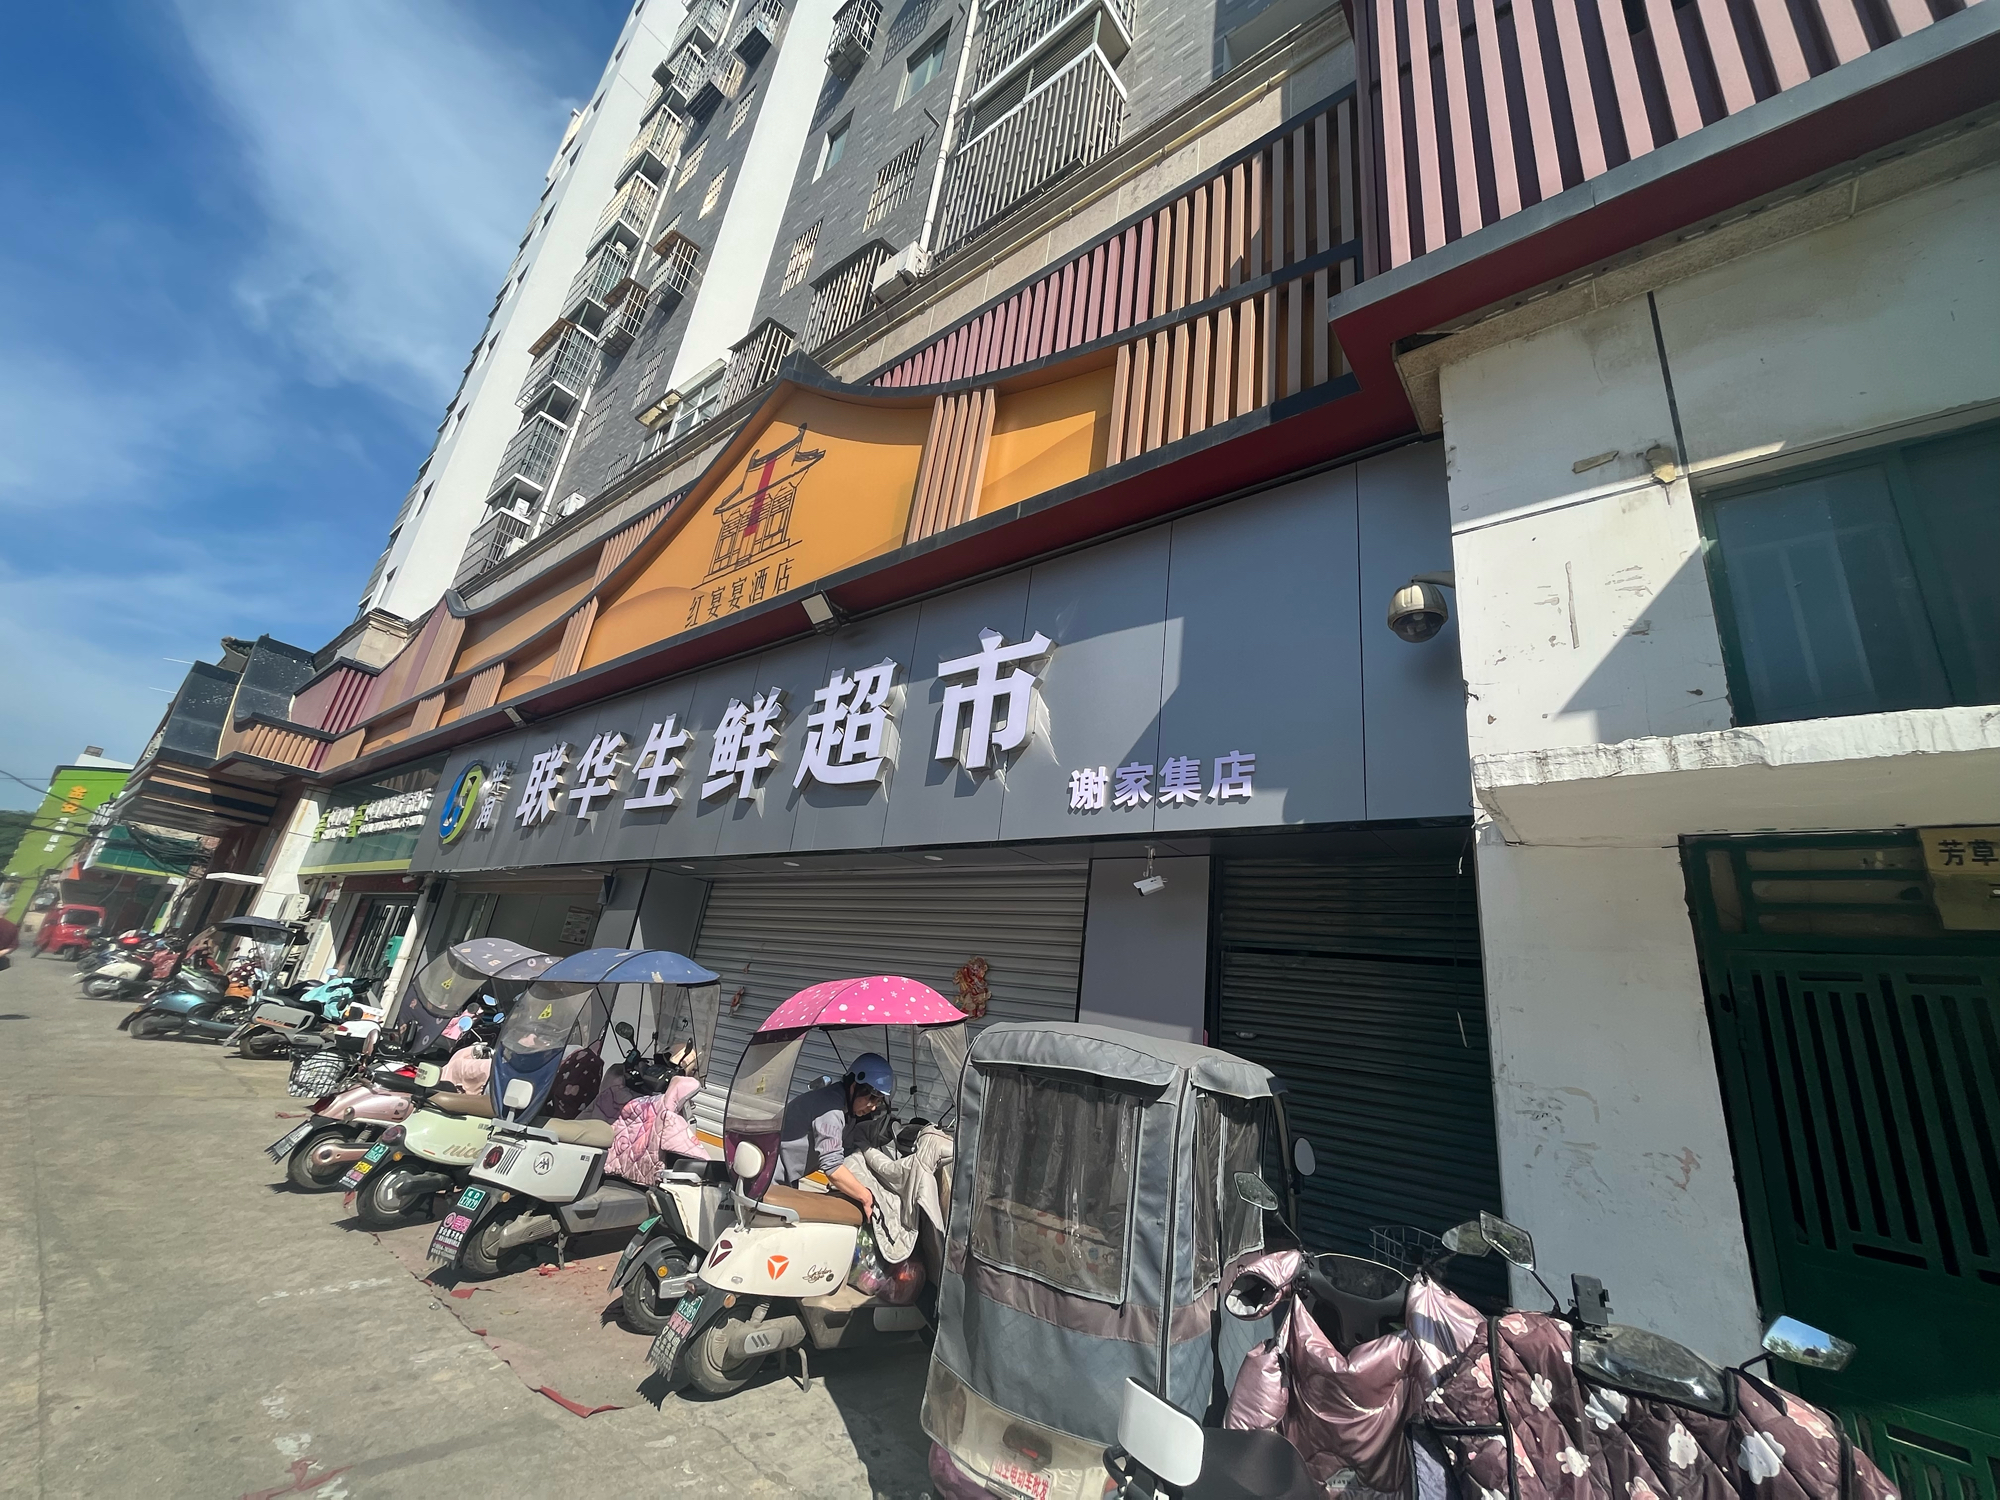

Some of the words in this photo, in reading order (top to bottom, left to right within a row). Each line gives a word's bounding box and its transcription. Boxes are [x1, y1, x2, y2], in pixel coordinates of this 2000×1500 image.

[684, 558, 795, 629] 红宴宴酒店
[514, 627, 1056, 829] 联华生鲜超市
[1068, 749, 1257, 811] 谢家集店
[1937, 838, 2000, 867] 芳草
